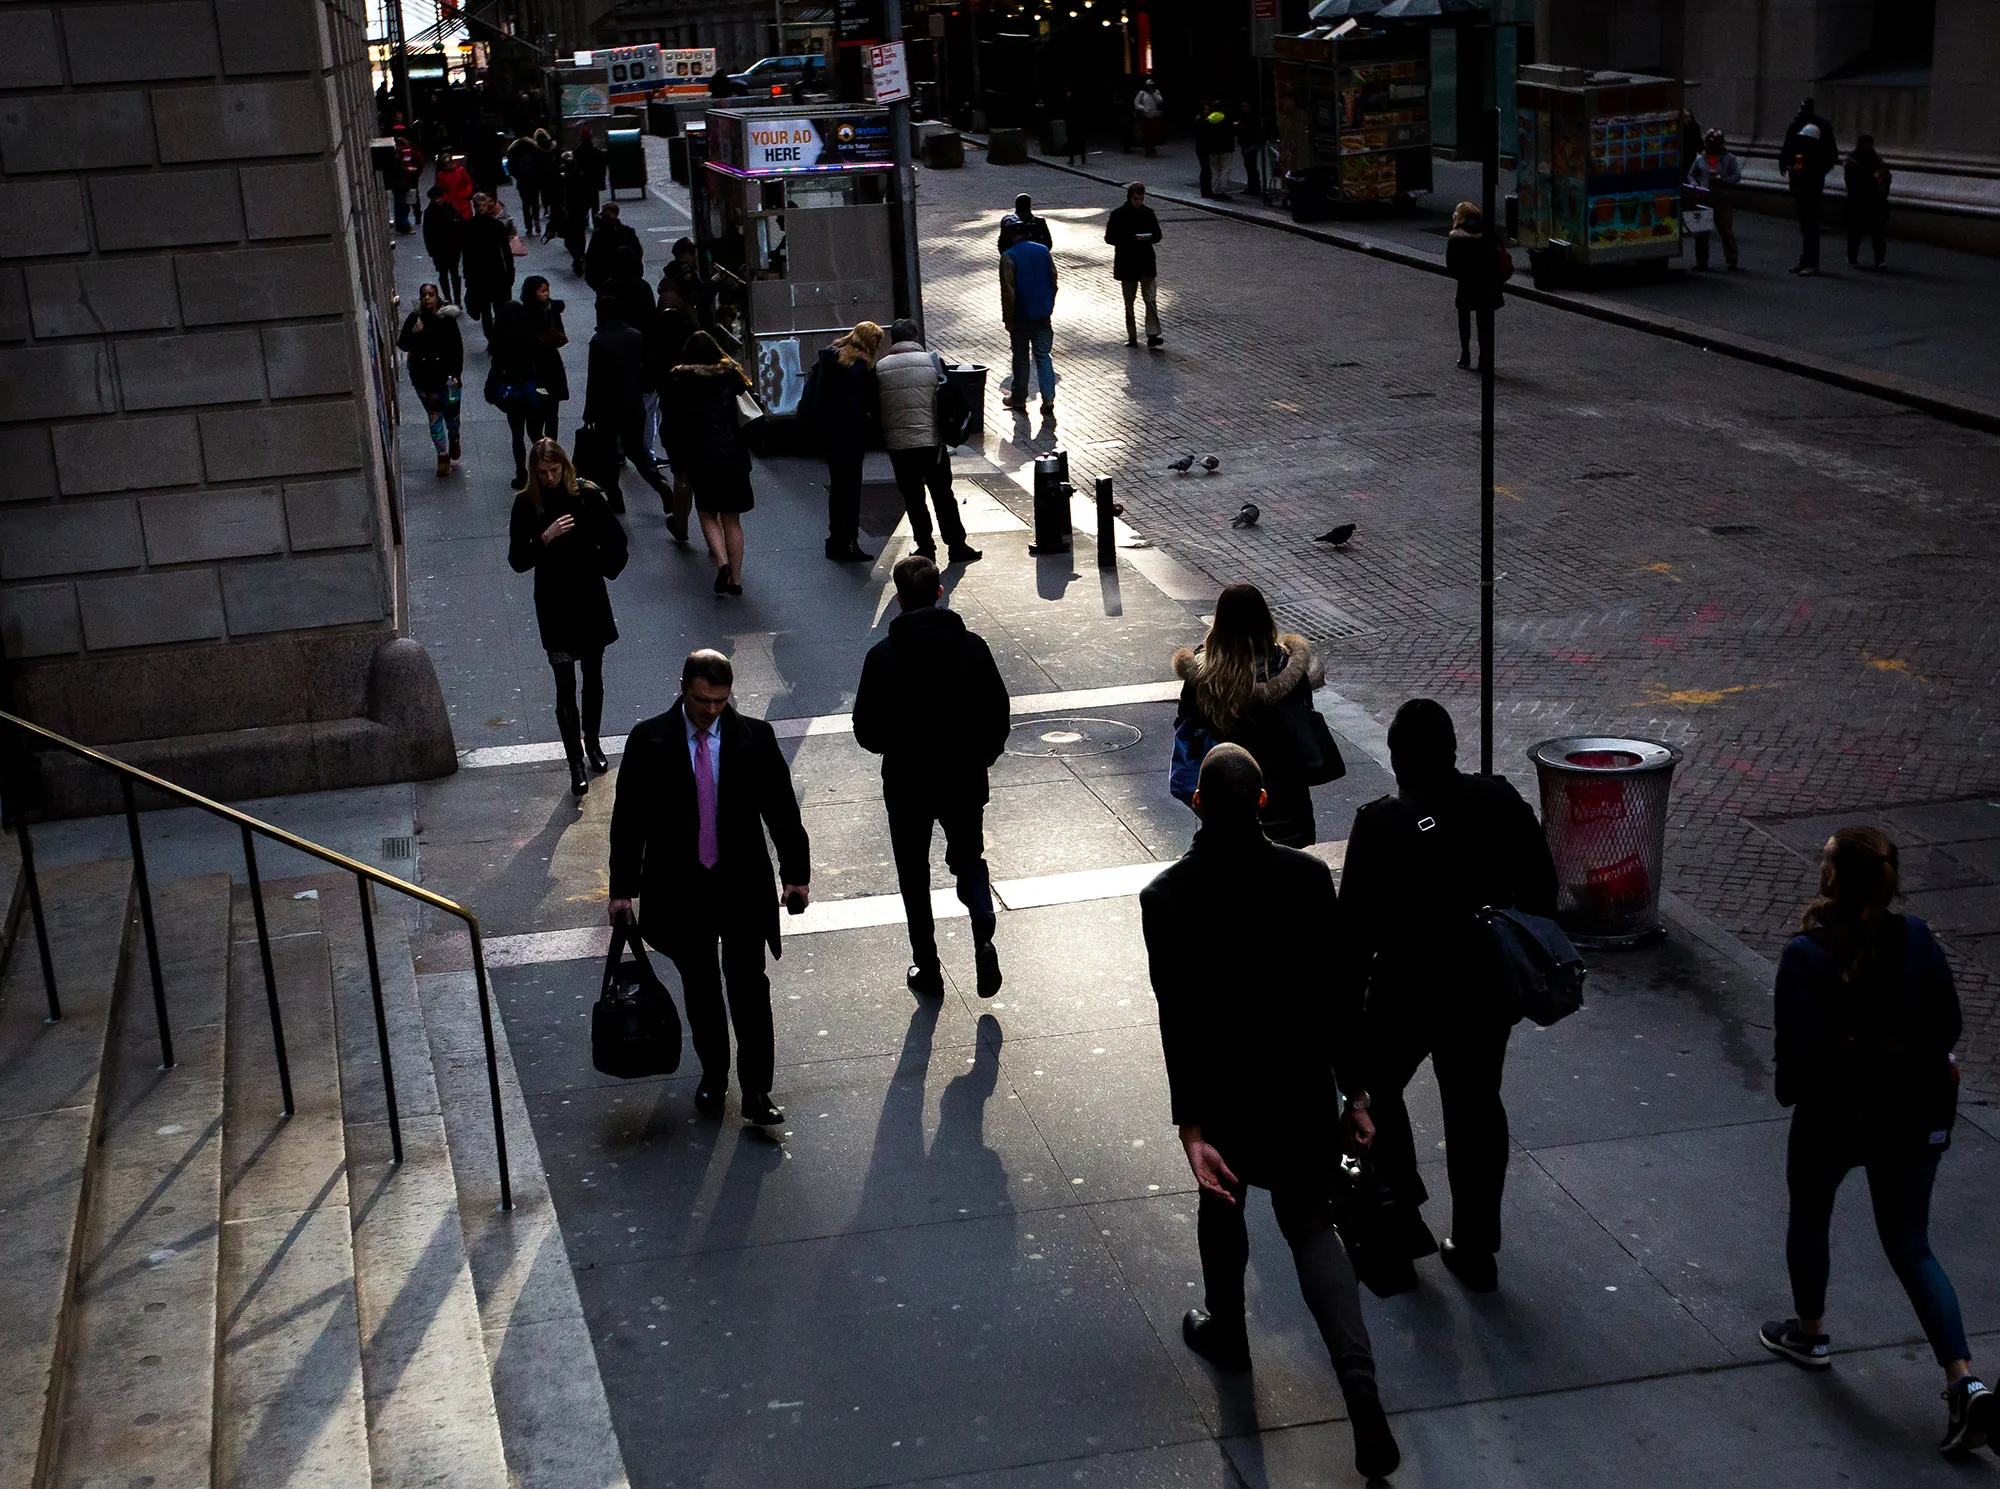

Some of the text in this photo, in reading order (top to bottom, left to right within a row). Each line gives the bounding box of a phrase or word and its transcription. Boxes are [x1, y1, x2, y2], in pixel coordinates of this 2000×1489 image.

[752, 130, 812, 145] YOUR AD
[765, 147, 801, 162] HERE
